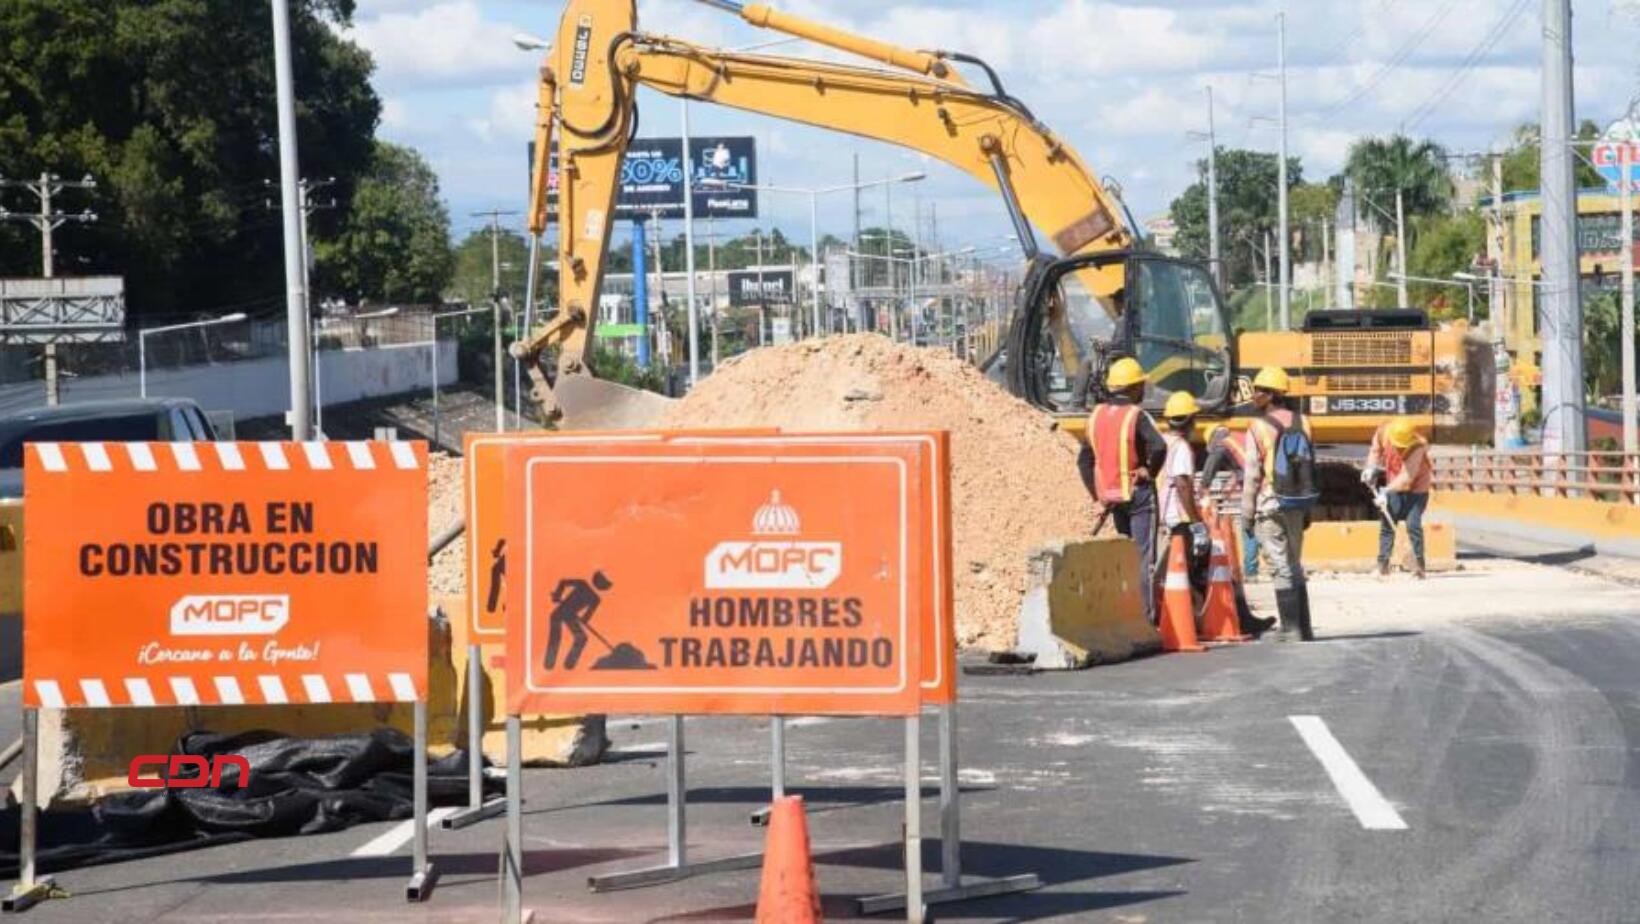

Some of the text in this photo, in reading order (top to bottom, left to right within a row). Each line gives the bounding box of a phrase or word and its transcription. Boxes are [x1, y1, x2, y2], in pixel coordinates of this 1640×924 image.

[1331, 399, 1395, 411] JS330
[147, 502, 314, 535] OBRA EN
[80, 541, 378, 576] CONSTRUCCION
[720, 547, 834, 573] MOPC
[184, 599, 283, 622] MOPC
[689, 597, 863, 628] HOMBRES
[219, 649, 233, 662] a
[238, 641, 256, 661] la
[658, 636, 894, 669] TRABAJANDO
